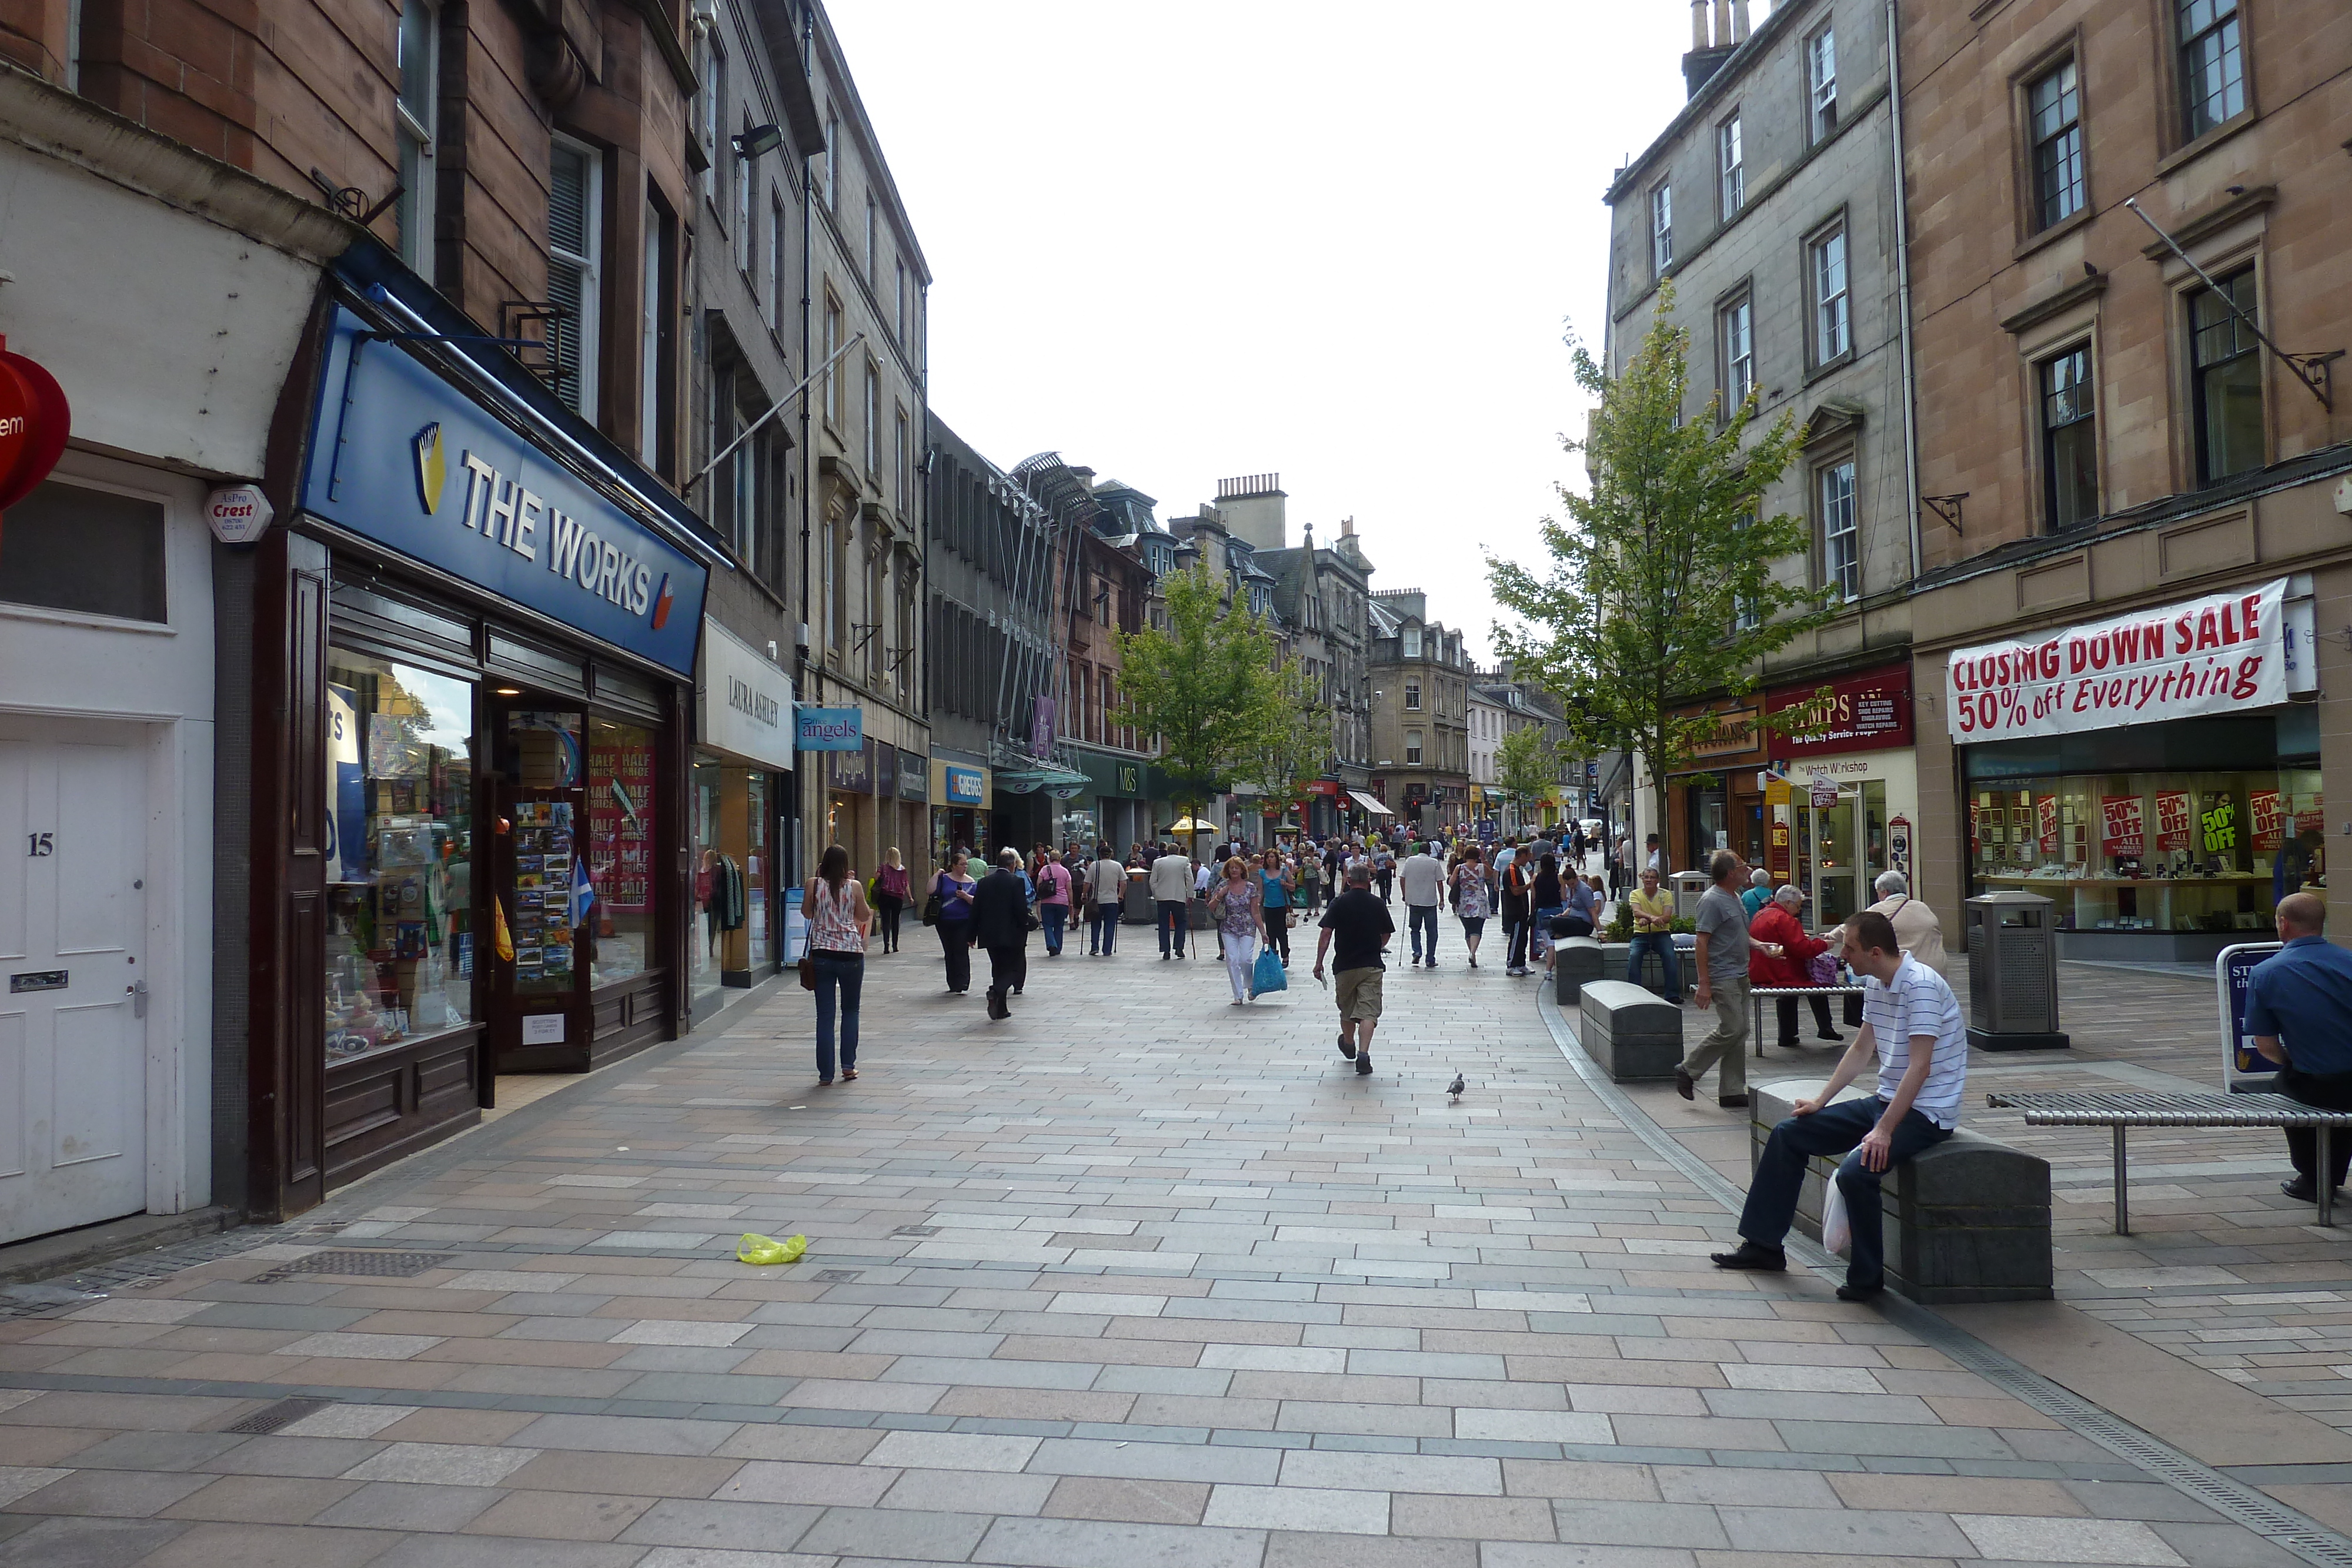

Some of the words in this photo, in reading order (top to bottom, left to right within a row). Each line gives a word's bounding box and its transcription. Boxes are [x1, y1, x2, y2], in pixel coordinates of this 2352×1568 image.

[213, 504, 253, 517] Crest
[462, 449, 543, 563] THE
[547, 507, 652, 616] WORKS
[1953, 640, 2059, 691] CLOSING
[2069, 617, 2164, 674] DOWN
[2175, 594, 2261, 654] SALE
[729, 675, 753, 717] LAURA
[754, 692, 779, 734] ASHLEY
[1958, 685, 2026, 733] 50%
[2033, 683, 2065, 719] off
[2072, 656, 2263, 713] Everything
[802, 720, 856, 742] angels
[1829, 730, 1853, 740] Service
[623, 754, 650, 766] HALF
[623, 767, 649, 776] PRICE
[1120, 766, 1136, 792] M&S
[626, 785, 650, 798] ALF
[958, 774, 982, 797] GREGGS
[2040, 799, 2055, 821] 50%
[2104, 800, 2139, 822] 50%
[2157, 795, 2186, 817] 50%
[2252, 794, 2280, 817] 50%
[2108, 817, 2142, 837] OFF
[2161, 813, 2188, 833] OFF
[2201, 803, 2234, 832] 50%
[28, 833, 54, 857] 15
[2204, 826, 2235, 851] OFF
[592, 882, 615, 895] ALF
